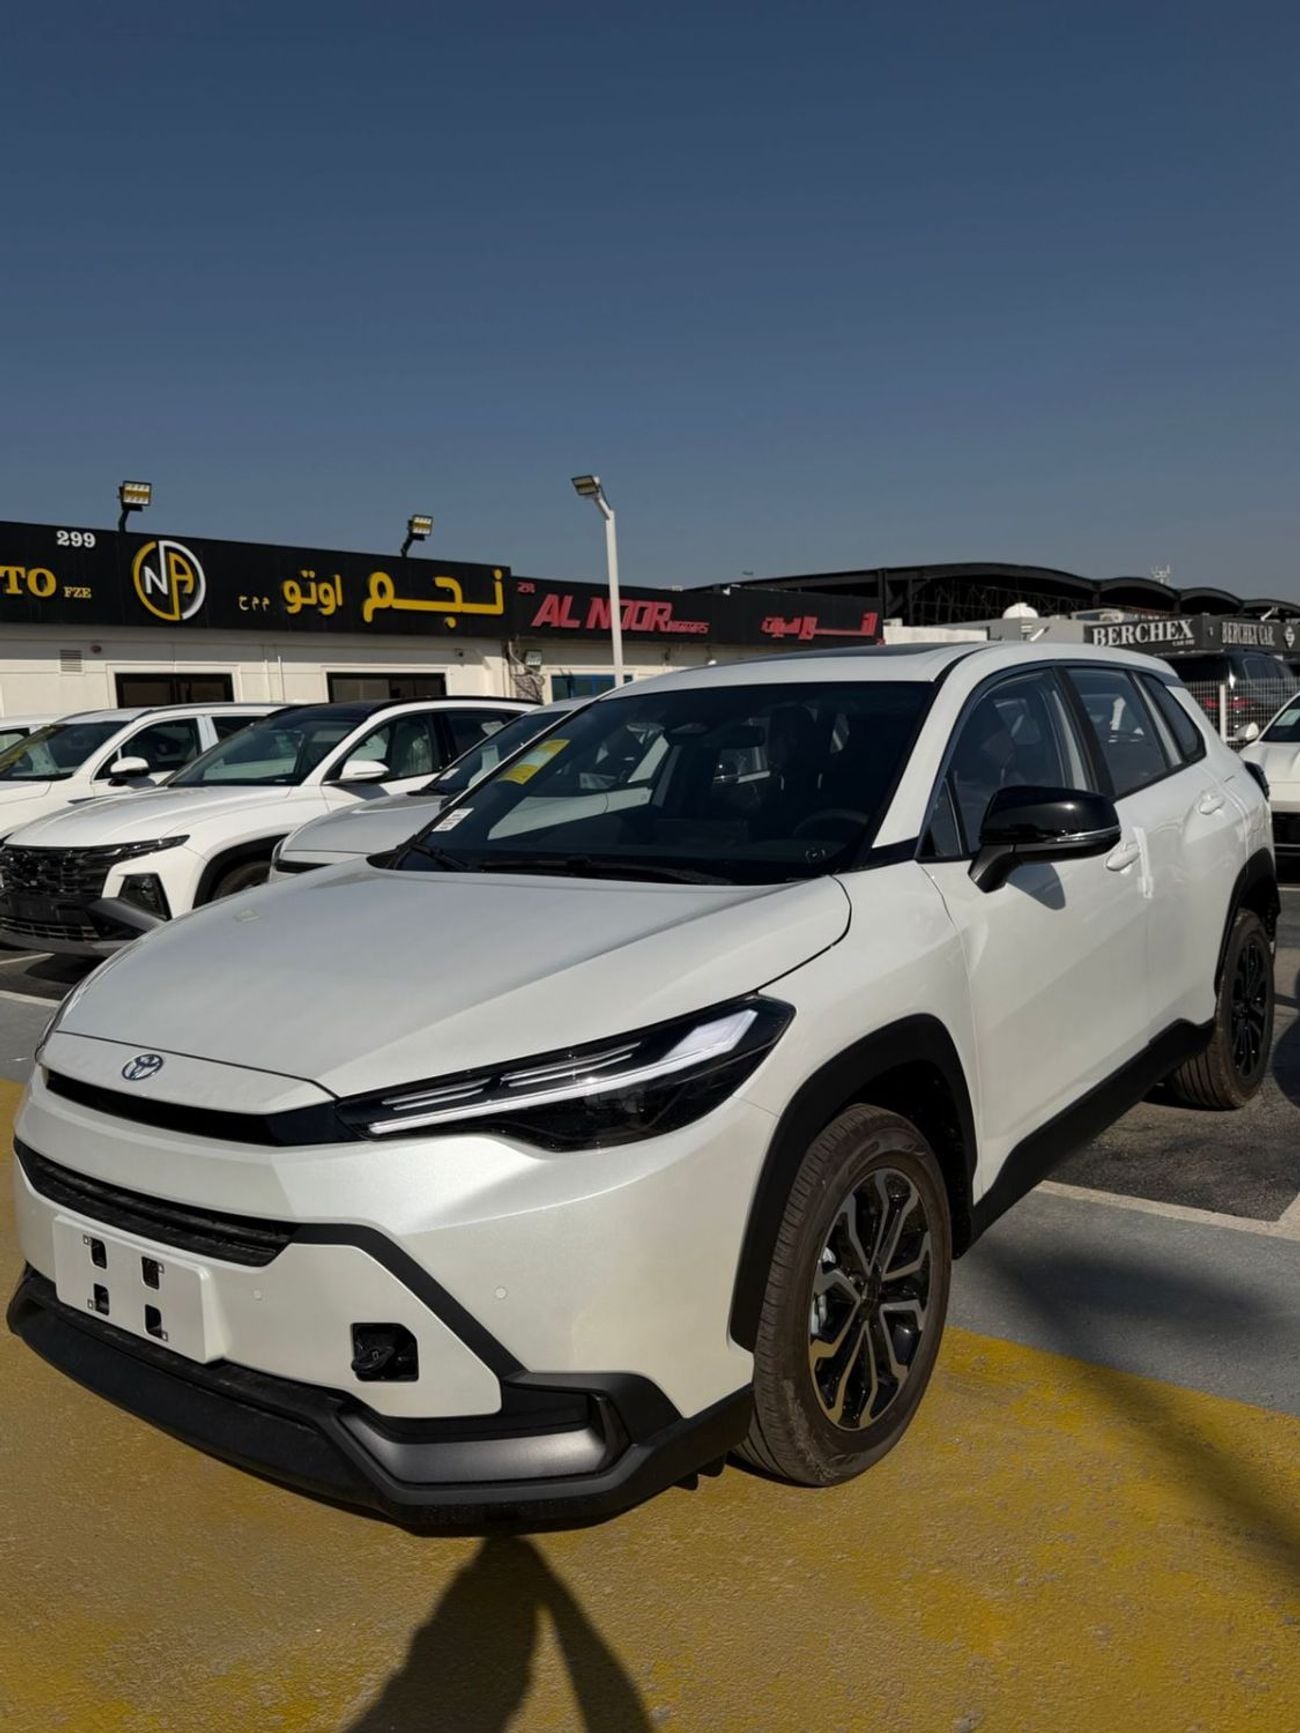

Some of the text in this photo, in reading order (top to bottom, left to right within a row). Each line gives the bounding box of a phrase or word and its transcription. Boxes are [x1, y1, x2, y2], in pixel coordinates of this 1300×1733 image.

[56, 530, 96, 548] 299
[64, 586, 92, 599] FZE
[363, 569, 504, 629] نجم
[531, 594, 581, 629] AL
[1092, 618, 1194, 646] BERCHEX
